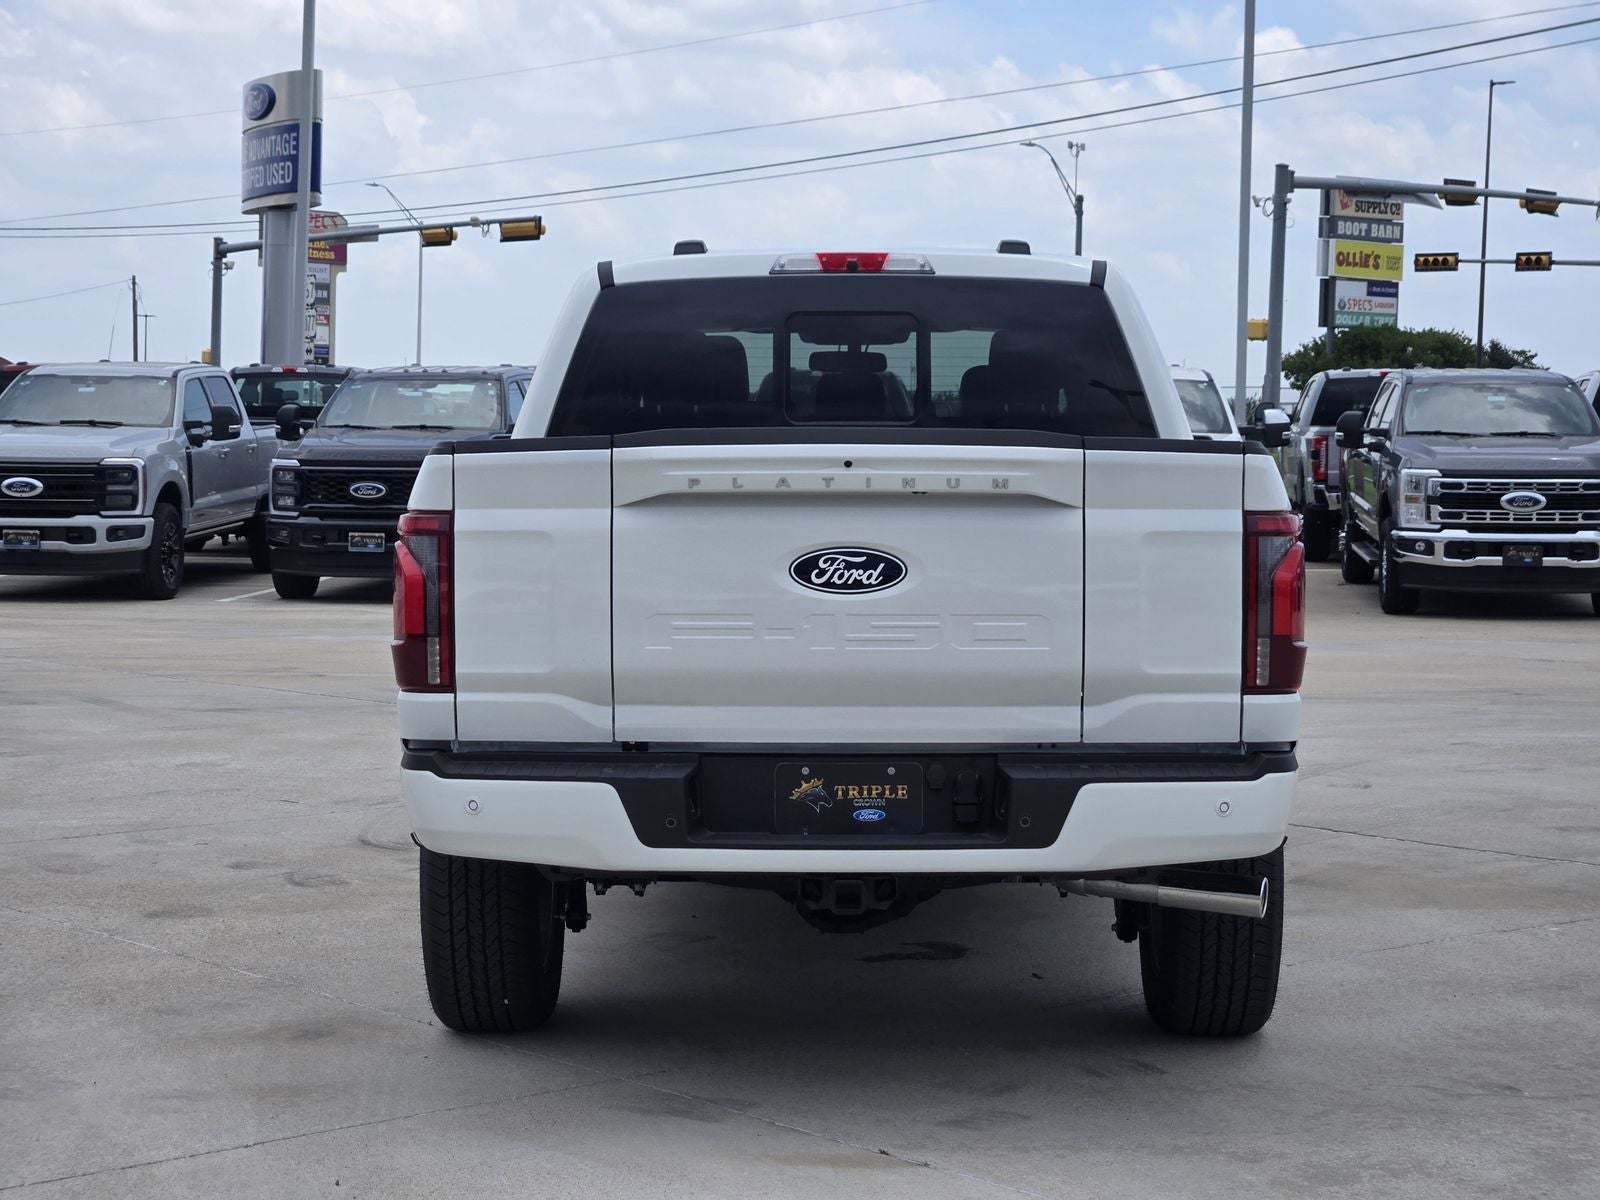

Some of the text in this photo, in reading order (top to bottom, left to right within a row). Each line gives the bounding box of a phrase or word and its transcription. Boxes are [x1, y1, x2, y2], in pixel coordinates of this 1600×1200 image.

[248, 132, 297, 161] ADVANTAGE
[266, 161, 293, 185] USED
[1355, 200, 1389, 215] SUPPLY
[1337, 221, 1401, 239] BOOT BARN
[308, 249, 336, 260] tness
[1336, 250, 1381, 271] OLLIE'S
[1347, 297, 1373, 311] SPEC'S
[1336, 314, 1396, 327] DOLLAR TREE
[688, 476, 1010, 490] PLATINUM
[834, 785, 908, 800] TRIPLE
